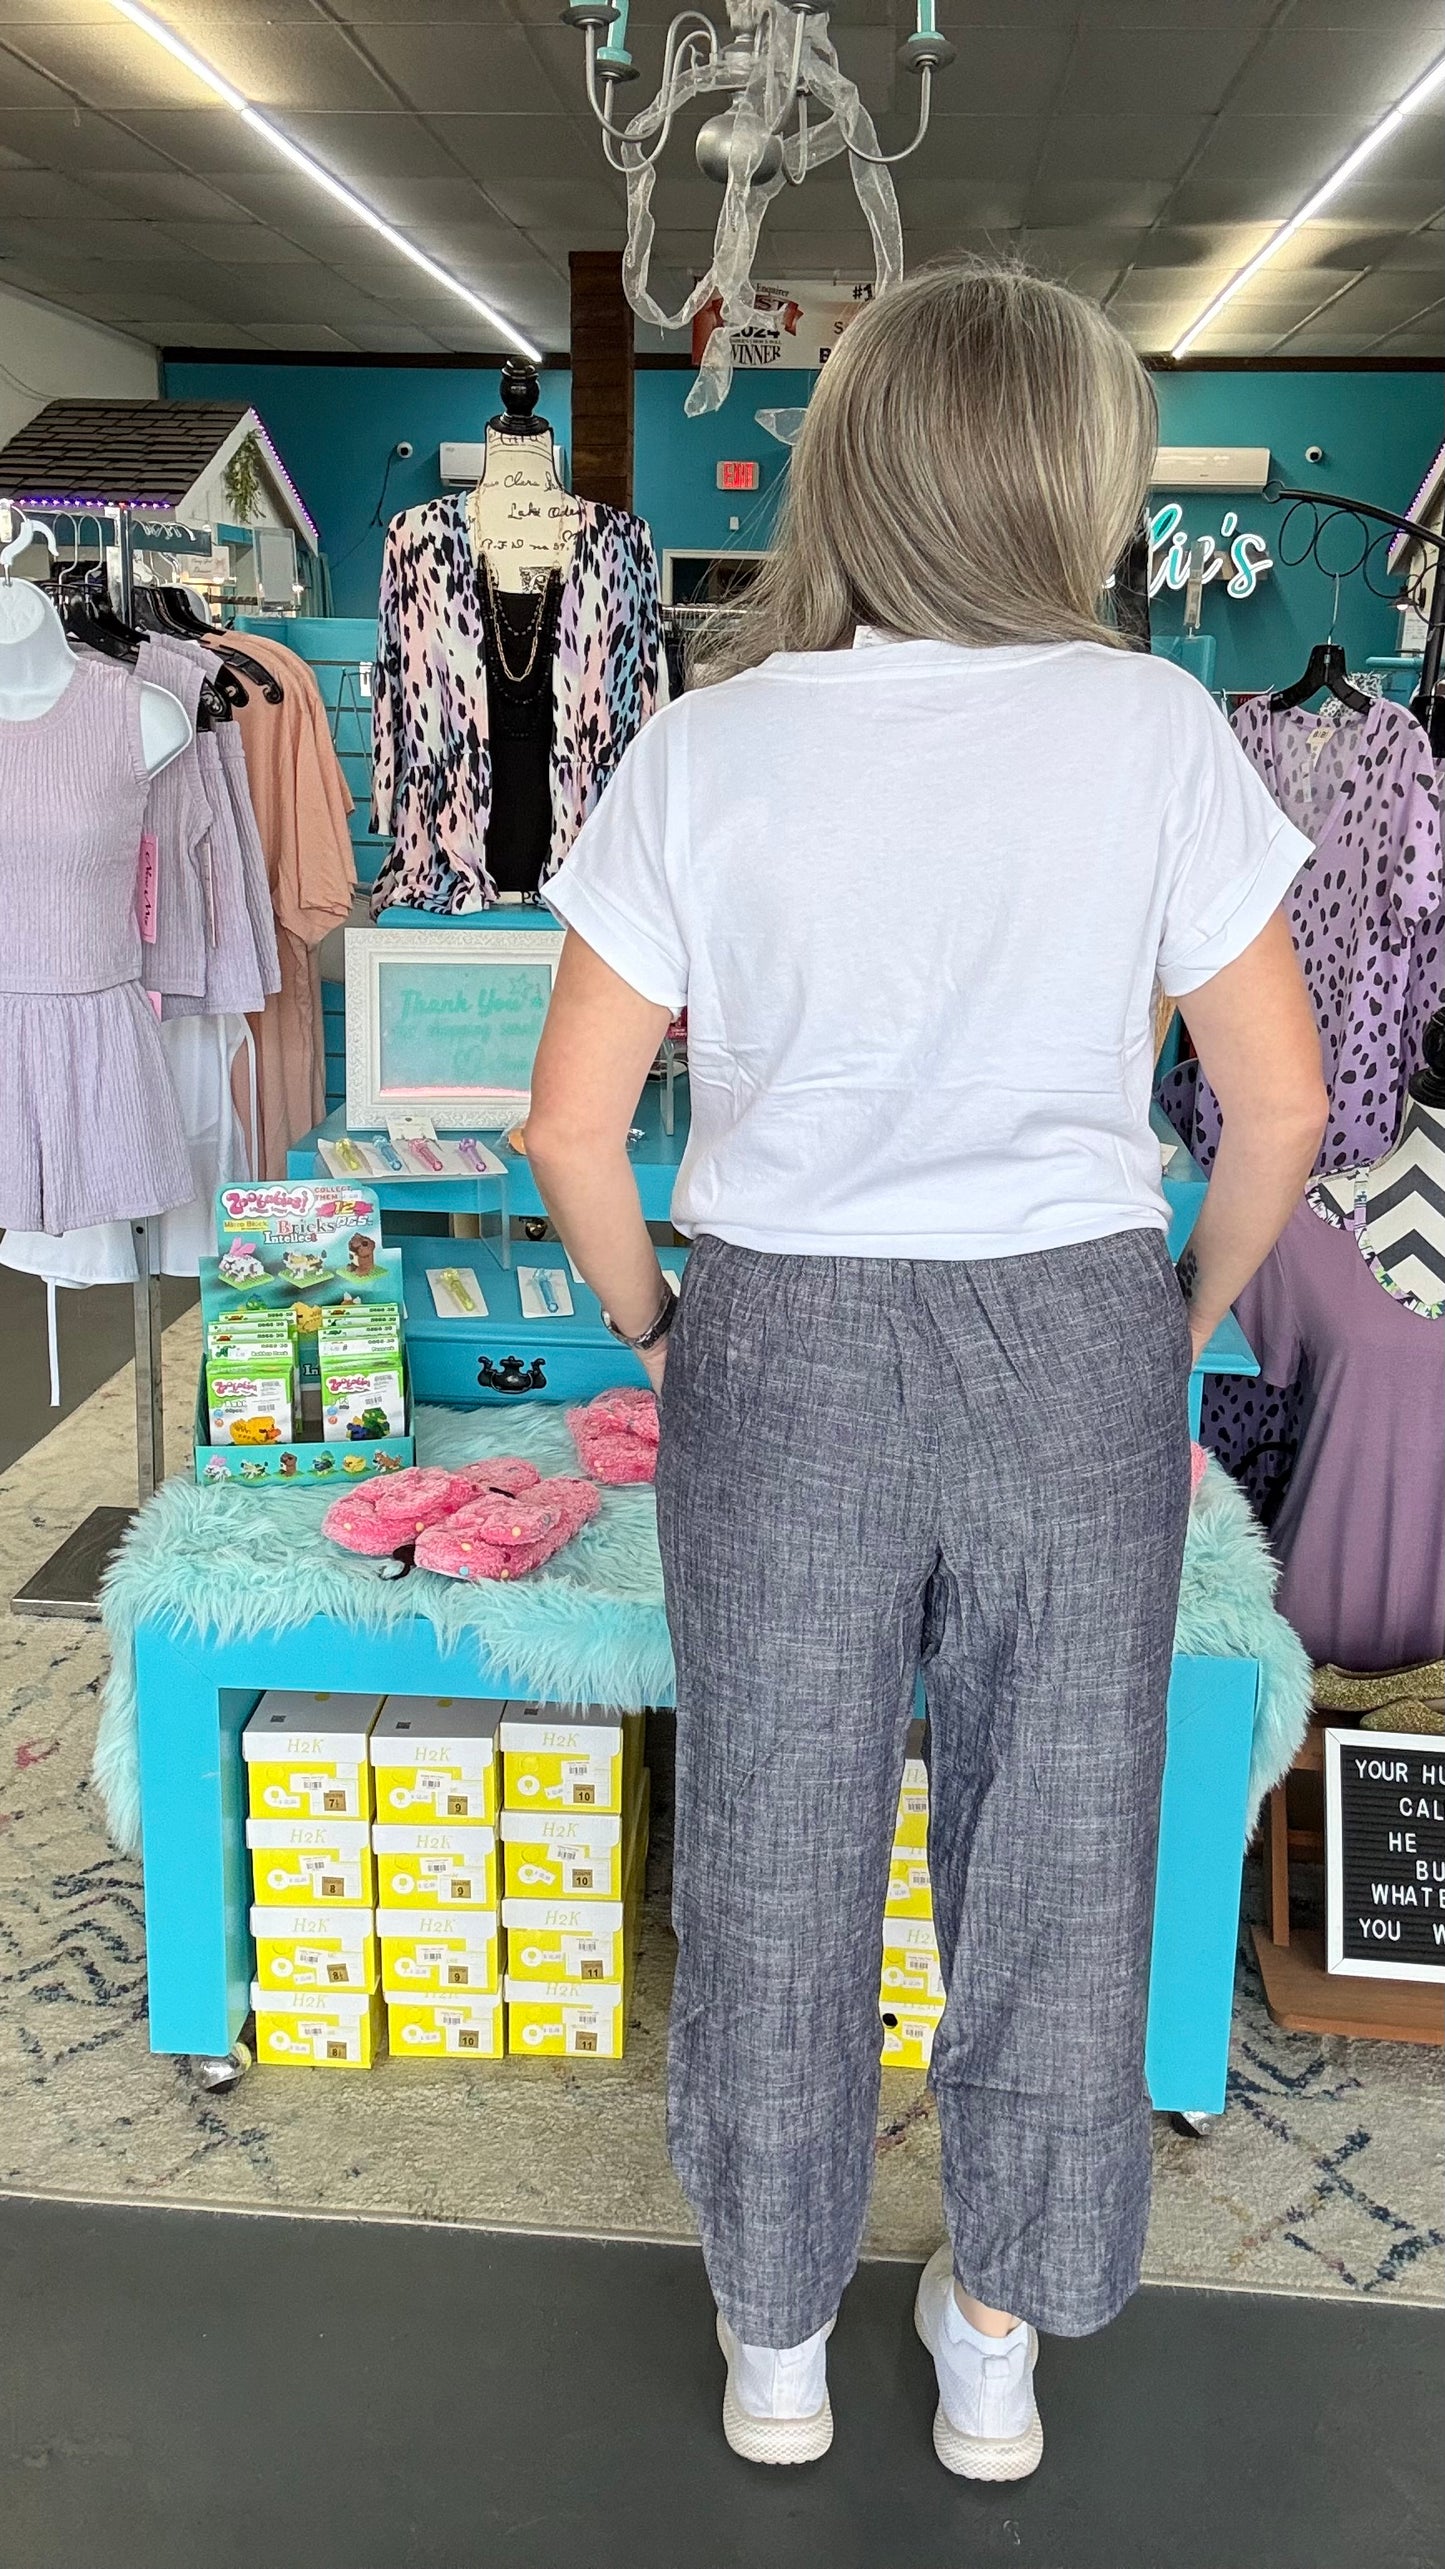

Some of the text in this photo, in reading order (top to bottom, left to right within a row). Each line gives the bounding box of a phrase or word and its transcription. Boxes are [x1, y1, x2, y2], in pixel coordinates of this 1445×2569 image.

[334, 1200, 356, 1216] 12
[278, 1218, 336, 1235] Bricks
[263, 1231, 318, 1244] Intellect
[287, 1738, 324, 1754] H2K
[542, 1731, 580, 1747] H2K
[414, 1746, 452, 1761] H2K
[1355, 1759, 1408, 1783] YOUR
[579, 1792, 590, 1801] 10
[455, 1803, 461, 1812] 9
[290, 1828, 327, 1844] H2K
[542, 1822, 580, 1838] H2K
[416, 1835, 454, 1849] H2K
[1388, 1831, 1417, 1853] HE
[330, 1884, 336, 1894] 8
[576, 1877, 588, 1886] 10
[457, 1886, 464, 1896] 9
[292, 1917, 330, 1933] H2K
[419, 1918, 457, 1933] H2K
[545, 1910, 582, 1926] H2K
[1358, 1917, 1401, 1942] YOU
[454, 1973, 461, 1982] 9
[588, 1968, 598, 1978] 11
[462, 2037, 474, 2046] 10
[583, 2041, 592, 2050] 11
